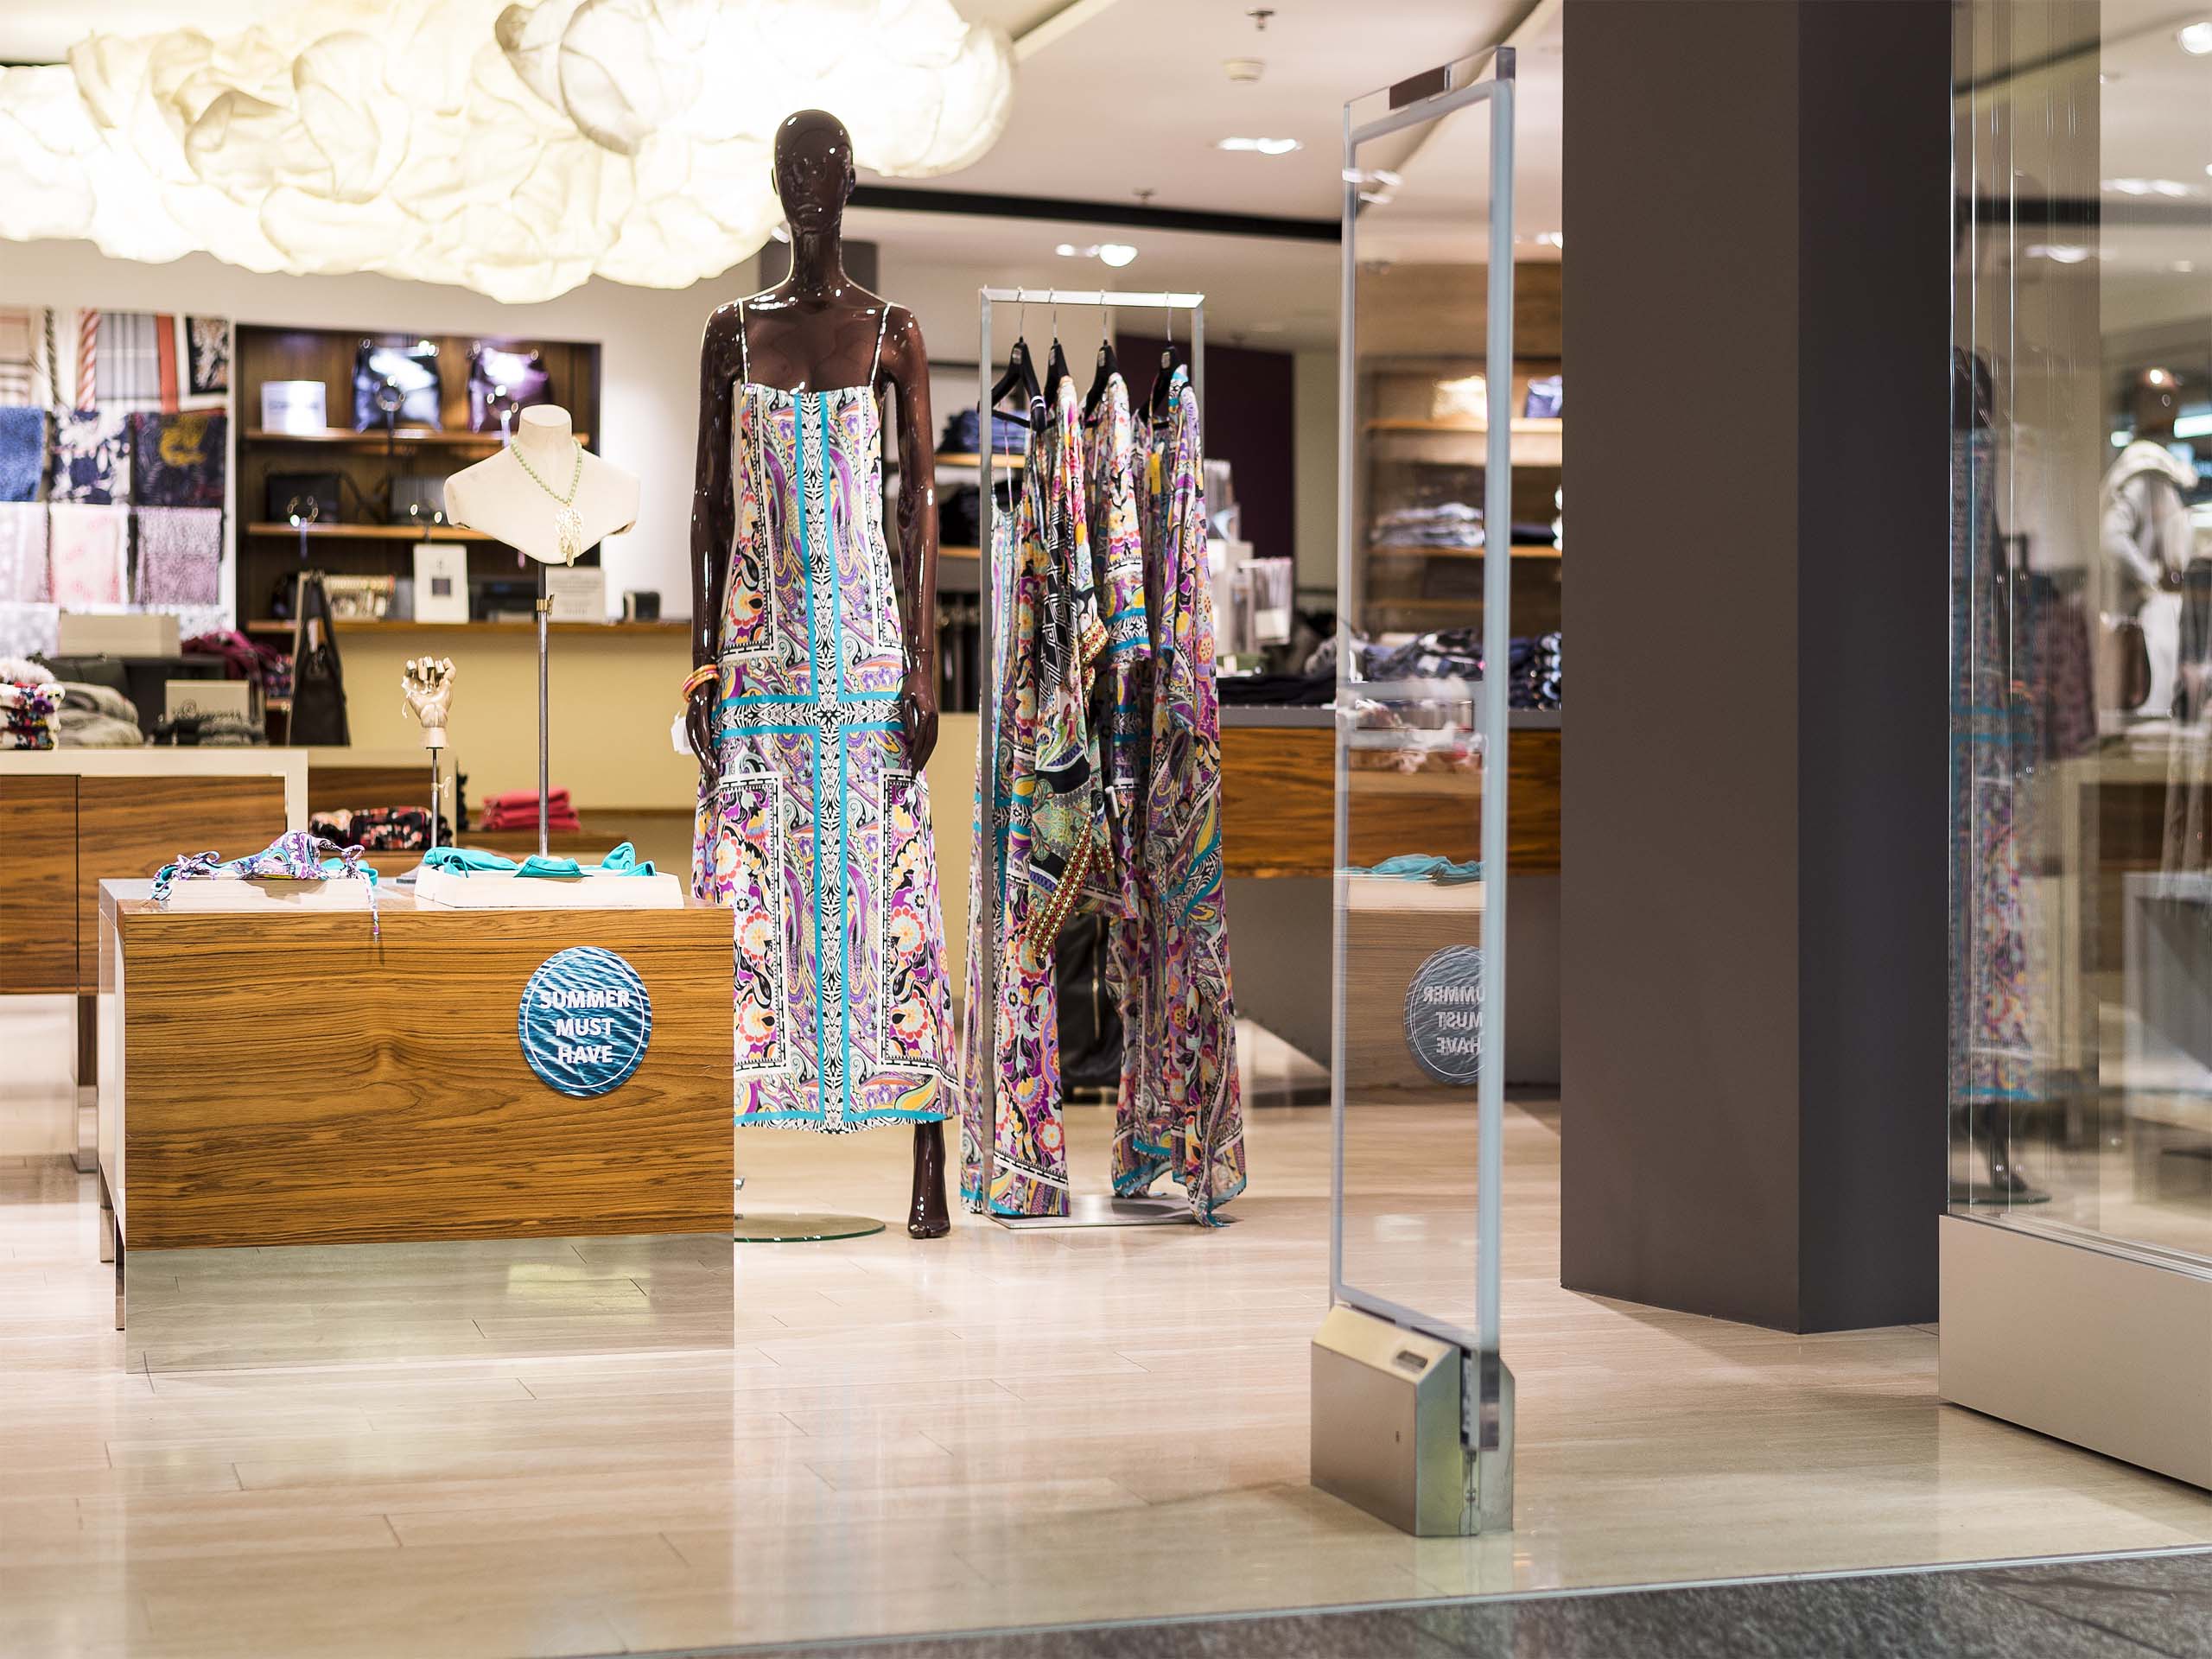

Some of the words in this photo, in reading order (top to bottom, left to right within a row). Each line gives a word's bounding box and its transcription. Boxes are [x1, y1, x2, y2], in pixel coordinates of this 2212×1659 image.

[540, 990, 630, 1009] SUMMER
[556, 1018, 614, 1037] MUST
[557, 1045, 613, 1064] HAVE
